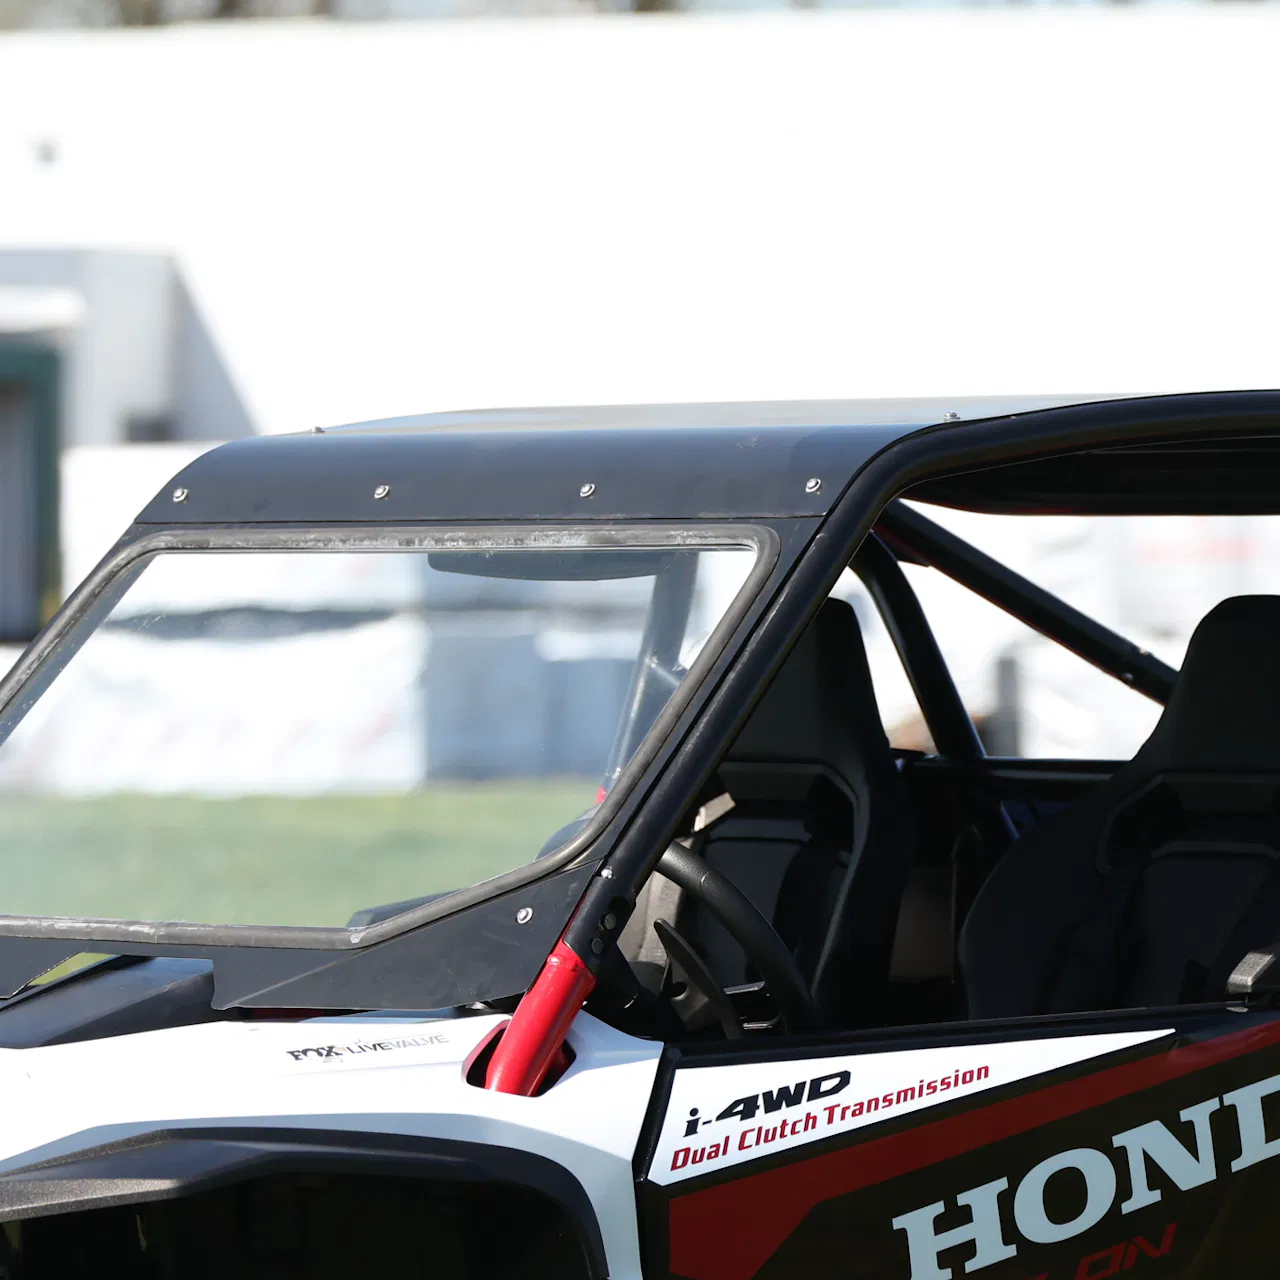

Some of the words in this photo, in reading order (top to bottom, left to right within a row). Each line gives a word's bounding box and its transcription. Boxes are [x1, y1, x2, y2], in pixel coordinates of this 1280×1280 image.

[286, 1045, 344, 1061] FOX
[670, 1136, 730, 1171] Dual
[738, 1112, 818, 1151] Clutch
[823, 1065, 991, 1125] Transmission
[683, 1070, 852, 1138] i-4WD
